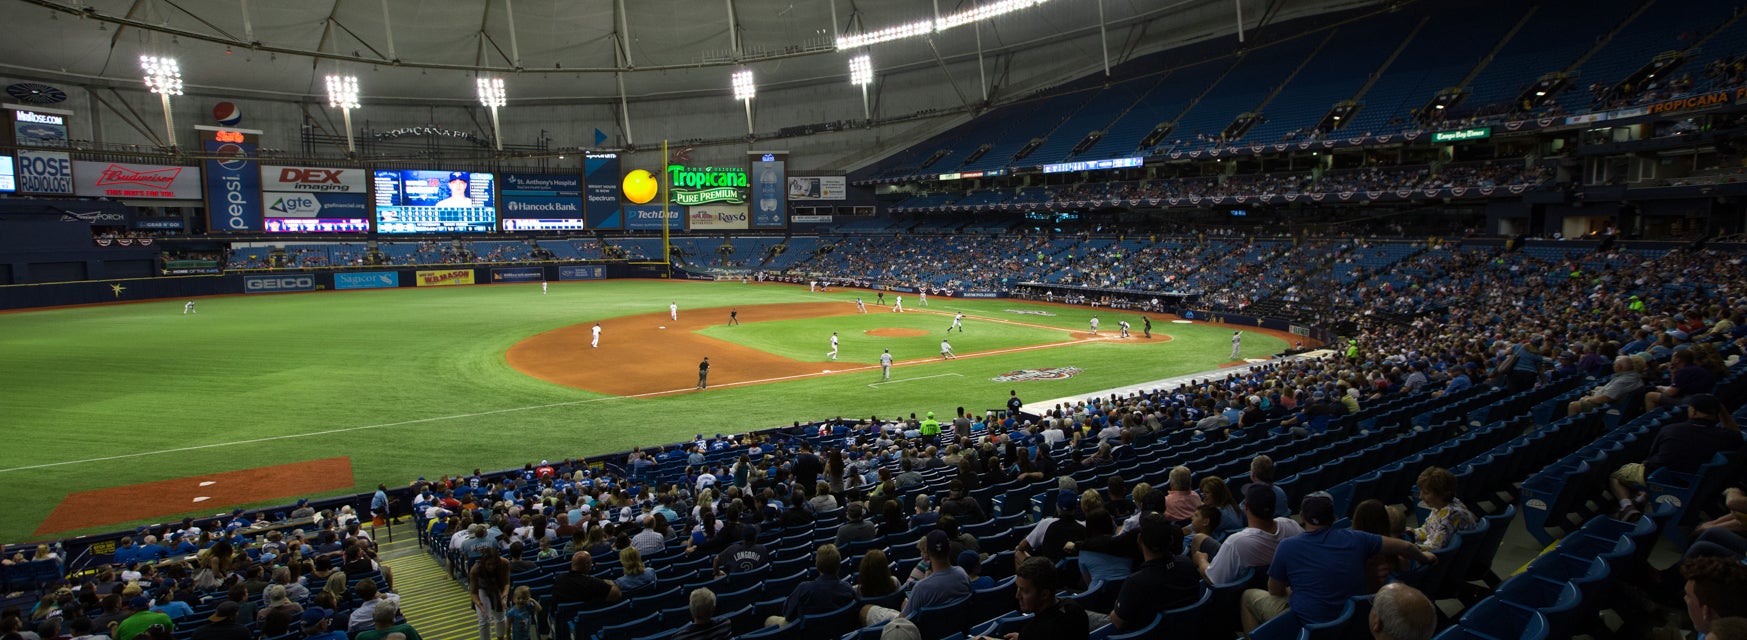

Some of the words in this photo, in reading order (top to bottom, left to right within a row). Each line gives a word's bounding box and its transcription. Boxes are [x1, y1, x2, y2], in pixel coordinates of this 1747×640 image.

[1647, 91, 1727, 114] TROPICANA
[1456, 131, 1467, 139] Bay
[19, 156, 71, 177] ROSE
[103, 169, 175, 183] Budweiser
[279, 168, 344, 184] DEX
[667, 164, 747, 189] Tropicana
[21, 175, 72, 193] RADIOLOGY
[294, 183, 350, 191] imaging
[525, 179, 553, 187] Anthony's
[677, 193, 699, 202] PURE
[700, 189, 738, 201] PREMIUM
[222, 176, 249, 229] pepsi
[287, 197, 313, 210] gte
[518, 202, 555, 211] Hancock
[555, 202, 577, 211] Bank
[637, 210, 658, 219] Tech
[658, 210, 679, 219] Dta
[739, 212, 746, 221] 6
[340, 273, 376, 285] Sagicor
[440, 271, 470, 281] MASON
[247, 278, 312, 290] GEICO
[733, 550, 761, 562] LONGORIA
